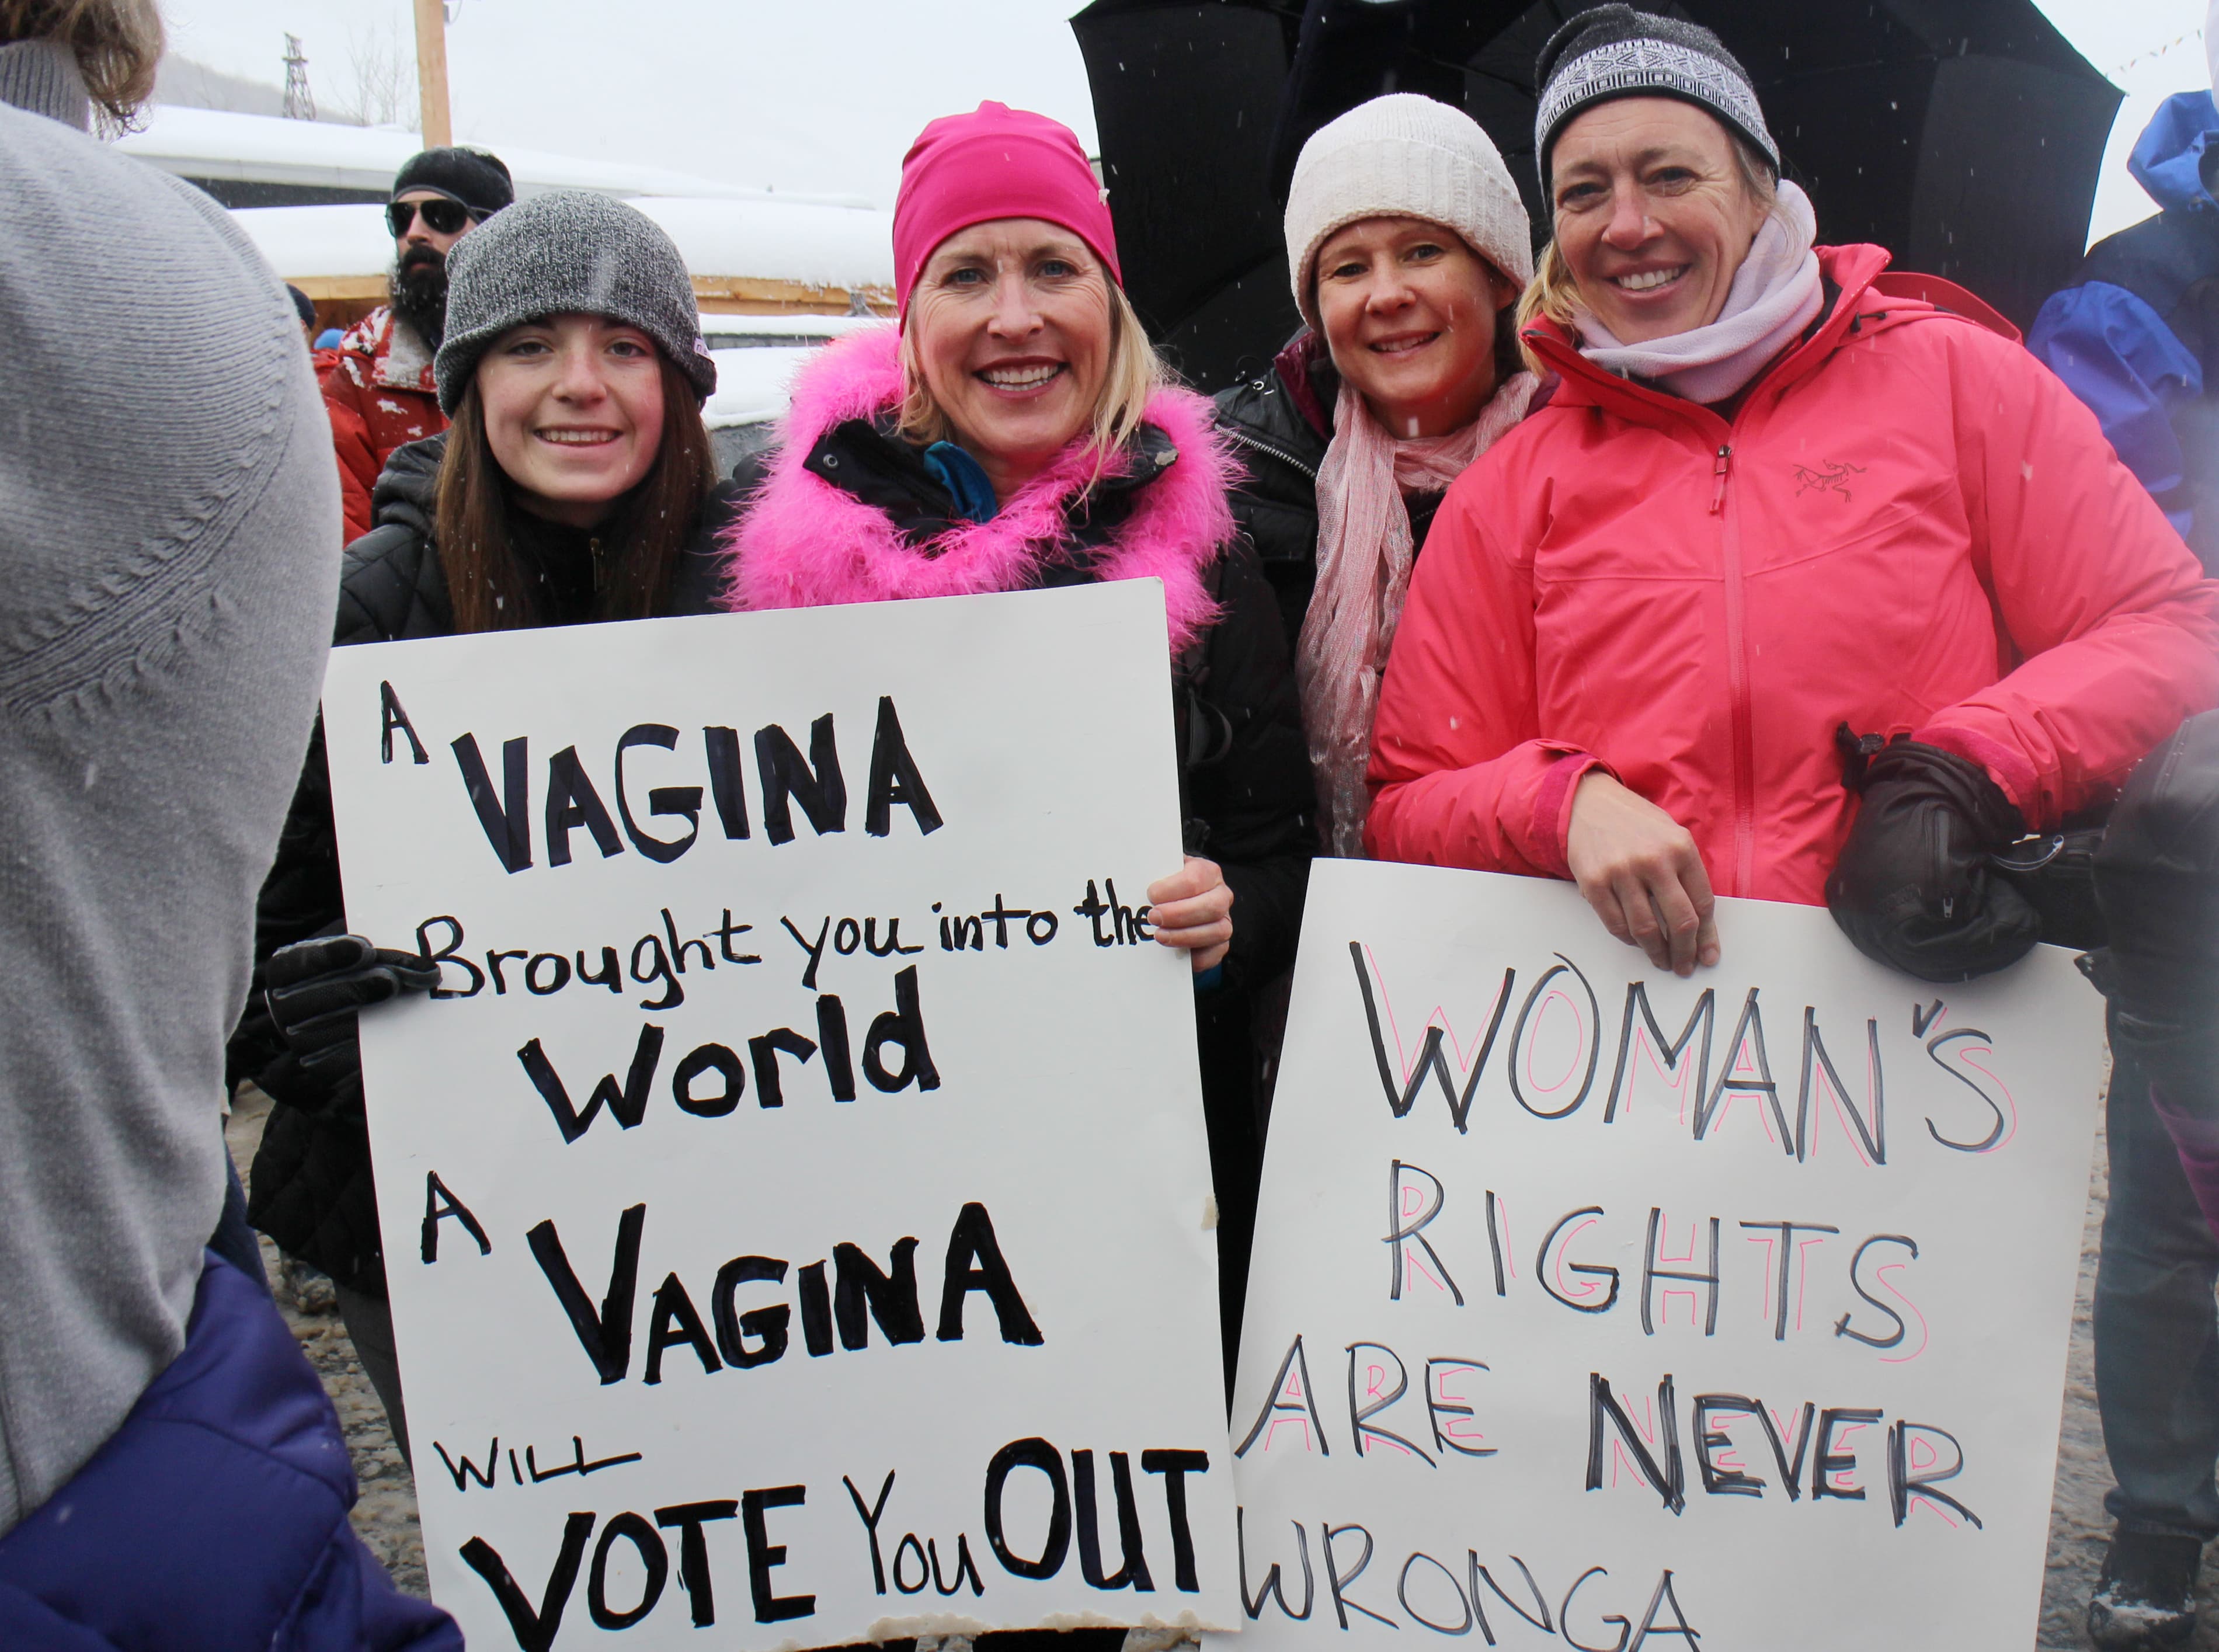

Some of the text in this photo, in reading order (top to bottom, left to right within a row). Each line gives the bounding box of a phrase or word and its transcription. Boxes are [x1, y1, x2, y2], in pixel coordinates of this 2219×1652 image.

[380, 680, 945, 875] A VAGINA
[415, 878, 1155, 1011] Brought you into the
[517, 964, 941, 1145] World
[1348, 940, 2017, 1167] WOMAN'S
[420, 1170, 1045, 1386] A VAGINA
[1380, 1159, 1928, 1362] RIGHTS
[432, 1435, 642, 1492] WILL
[1233, 1333, 1984, 1531] ARE NEVER
[458, 1436, 1210, 1652] VOTE You OUT
